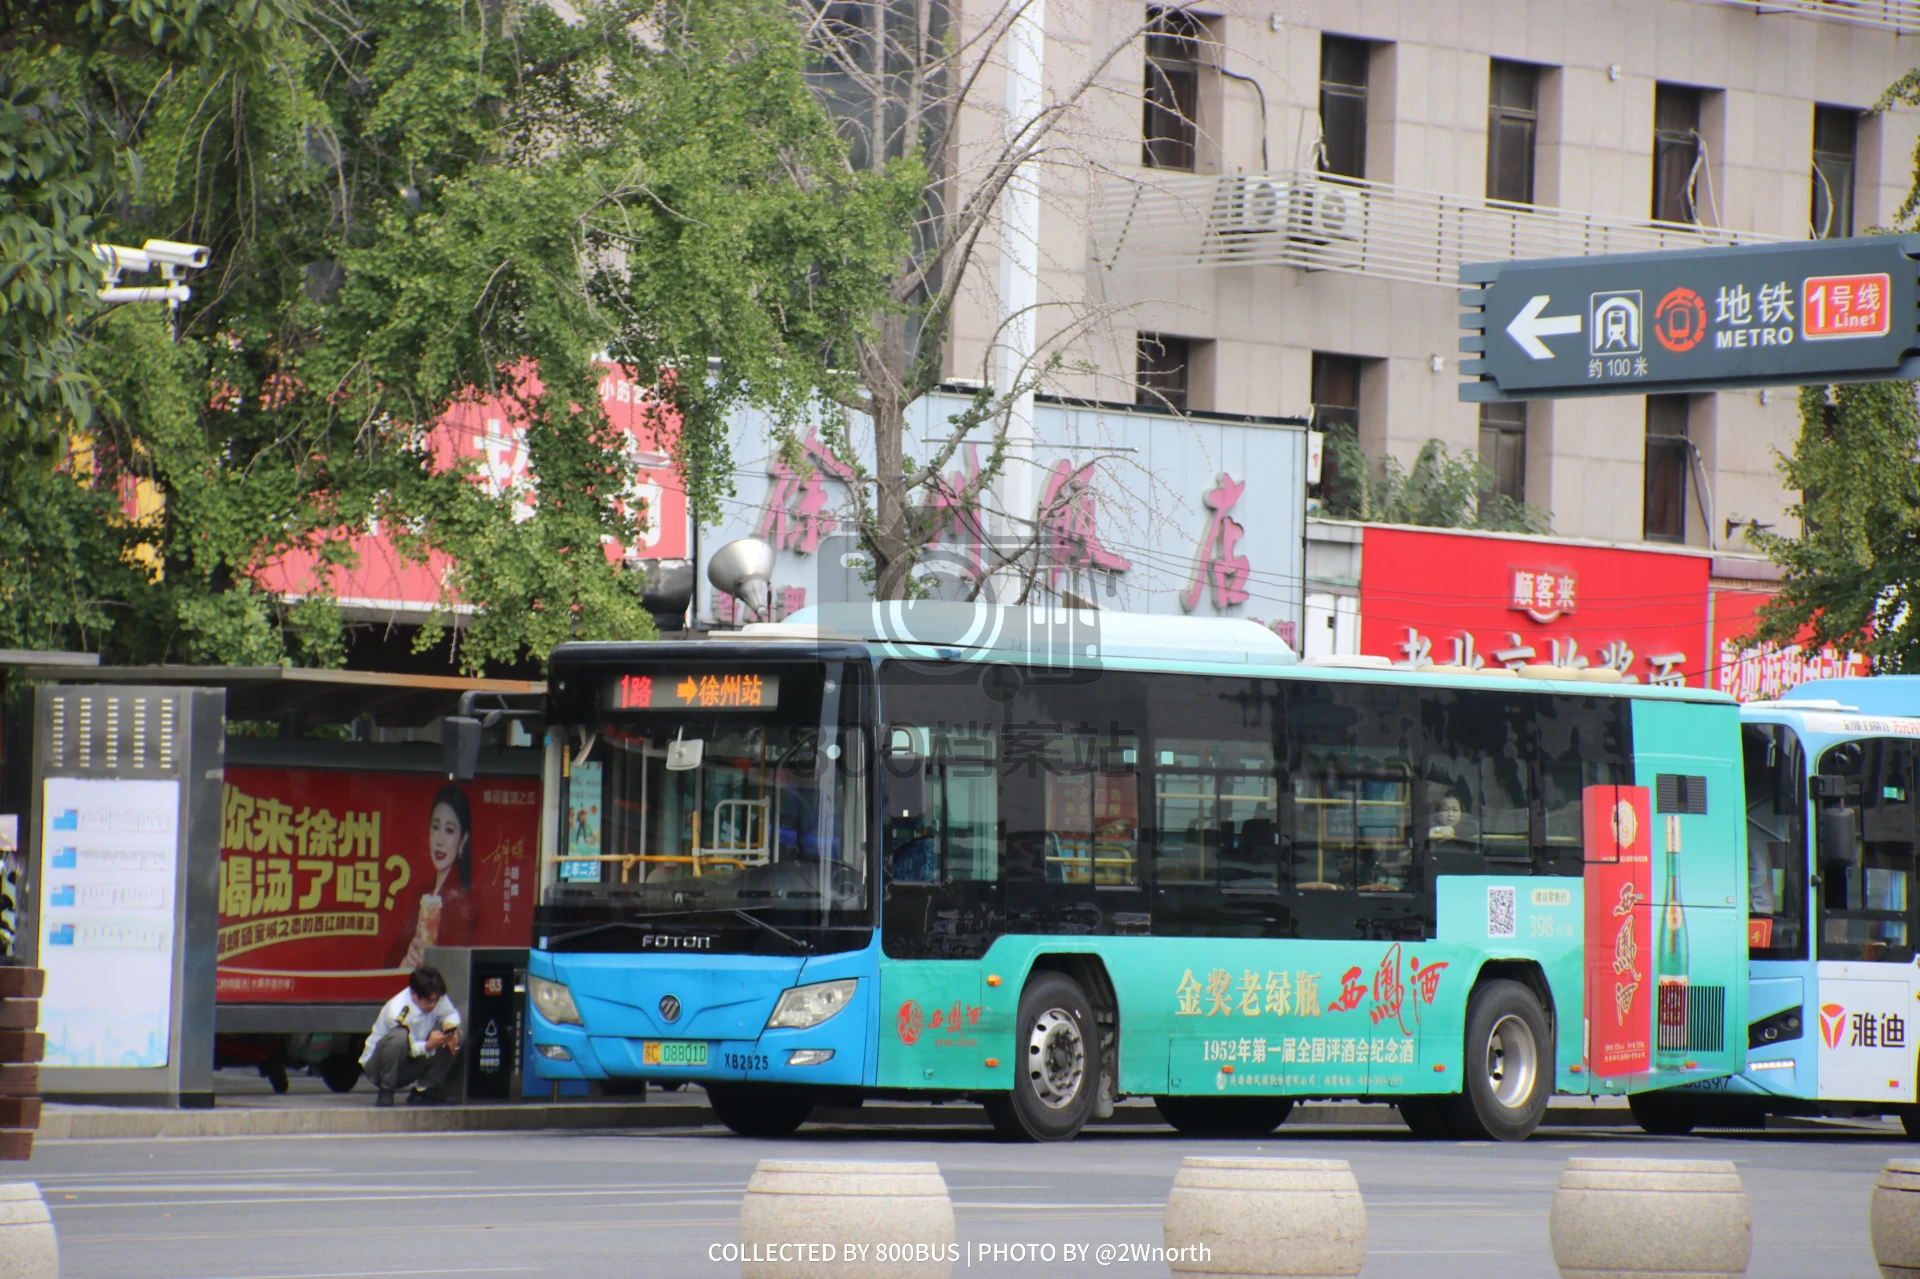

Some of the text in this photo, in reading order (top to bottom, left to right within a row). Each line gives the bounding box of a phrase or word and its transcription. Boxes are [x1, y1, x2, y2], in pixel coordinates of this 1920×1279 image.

[1715, 281, 1795, 325] 地铁
[1808, 282, 1881, 330] 1号线
[1833, 312, 1878, 329] Line1
[1715, 326, 1795, 349] METRO
[1513, 571, 1576, 609] 顺客来
[620, 674, 763, 708] 1路 徐州站
[220, 782, 381, 859] 你来徐州
[642, 934, 712, 949] FOTON
[1174, 967, 1322, 1018] 金奖老绿瓶
[1851, 1011, 1906, 1048] 雅迪
[1202, 1037, 1414, 1064] 1952年第一届全国评酒会纪念酒
